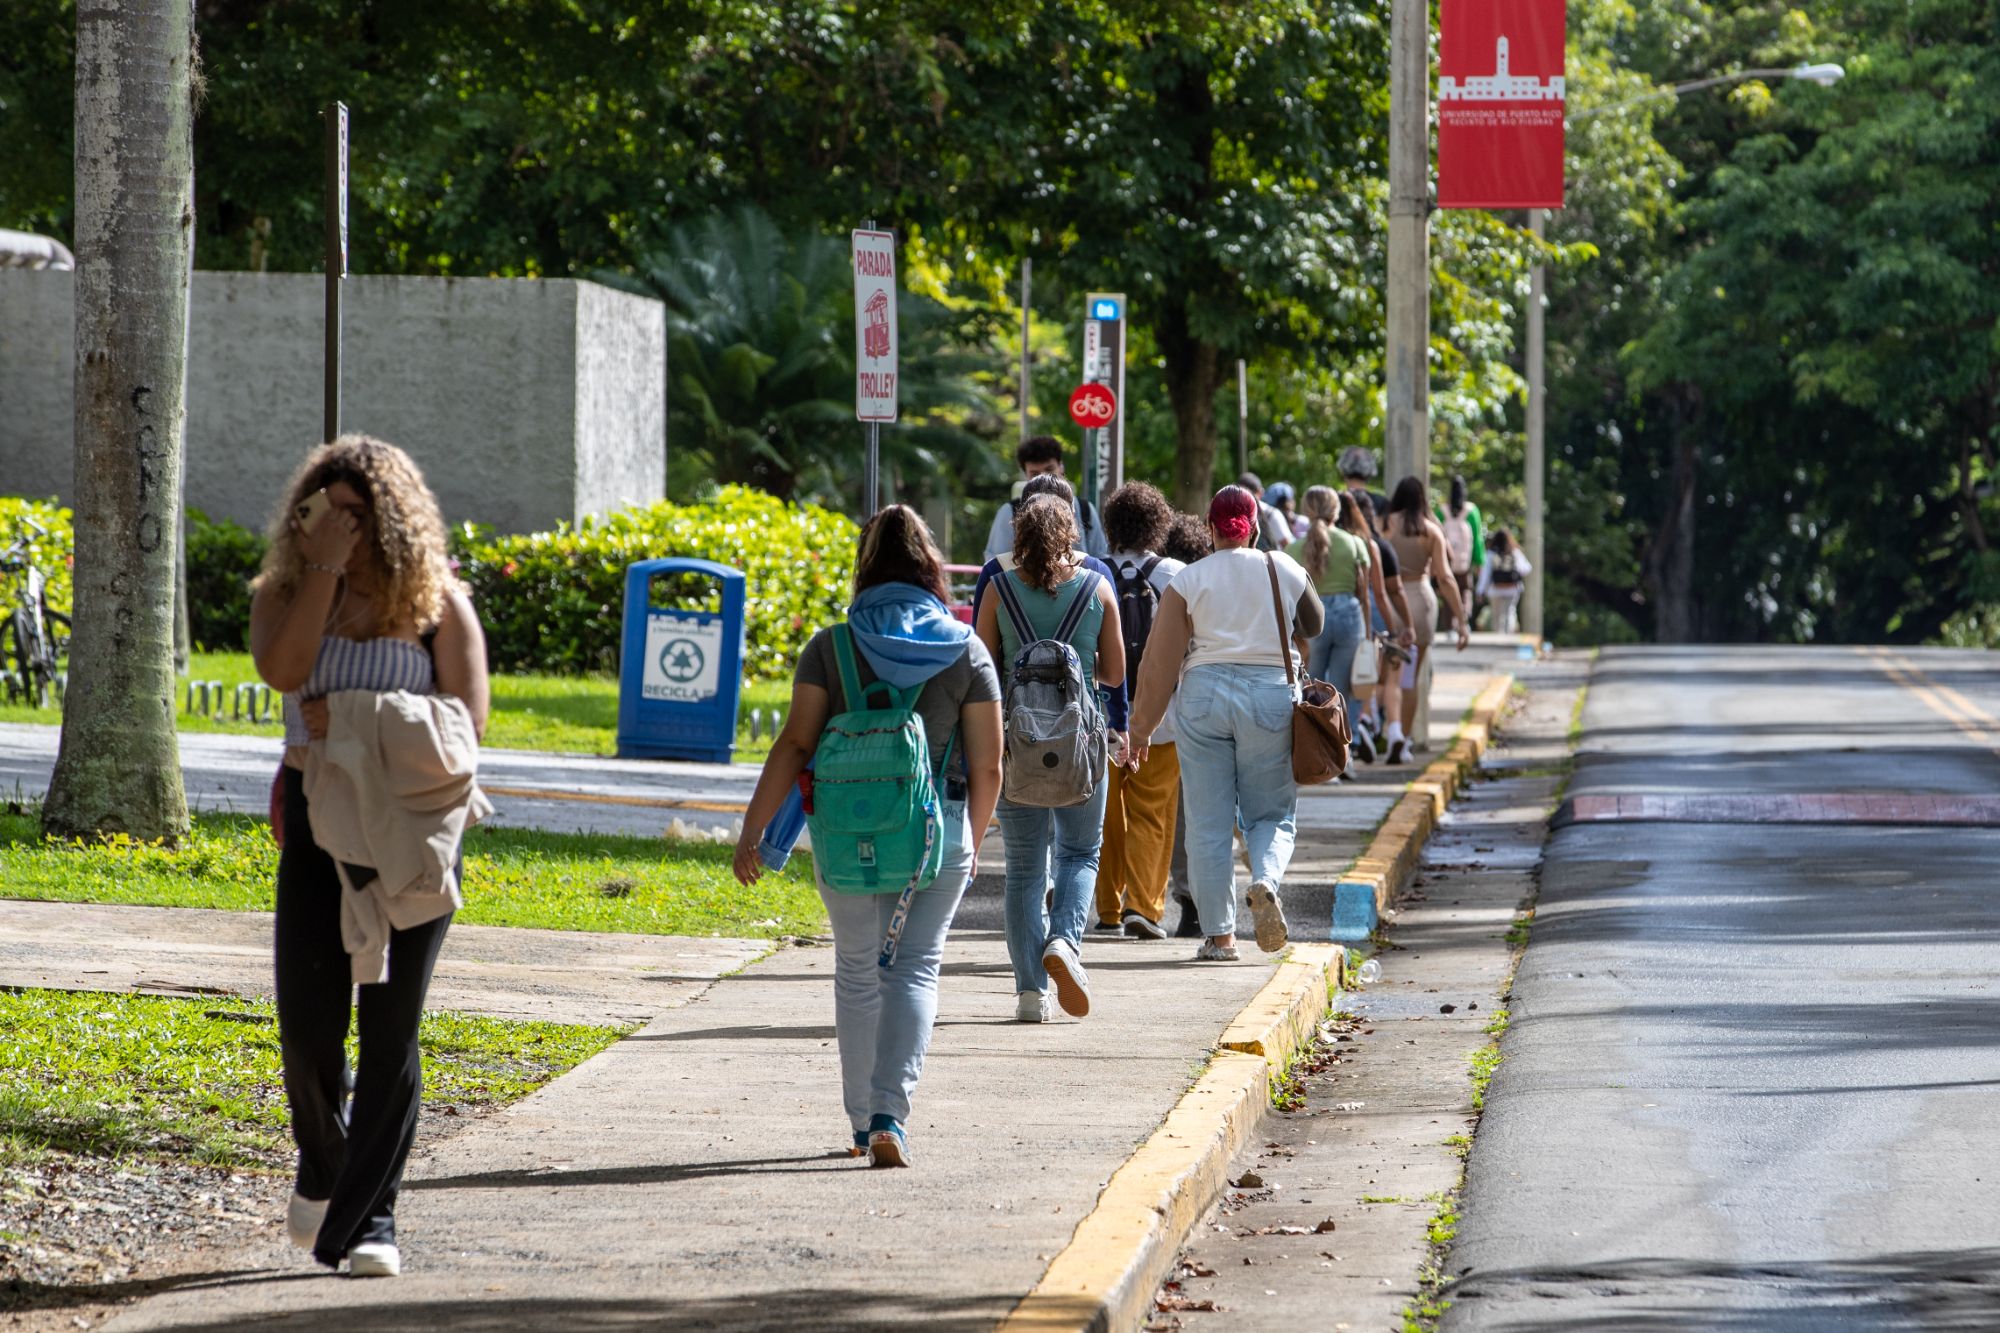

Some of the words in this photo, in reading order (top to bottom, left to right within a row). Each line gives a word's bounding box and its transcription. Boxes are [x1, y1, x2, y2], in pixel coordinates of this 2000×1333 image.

[1442, 110, 1495, 118] UNIVERSIDAD
[1497, 110, 1507, 118] DE
[1510, 110, 1541, 118] PUERTO
[1542, 110, 1562, 118] RICO
[1450, 118, 1484, 126] RECINTO
[1487, 118, 1497, 126] DE
[1519, 118, 1553, 126] PIEDRAS
[857, 249, 892, 278] PARADA
[860, 372, 895, 399] TROLLEY
